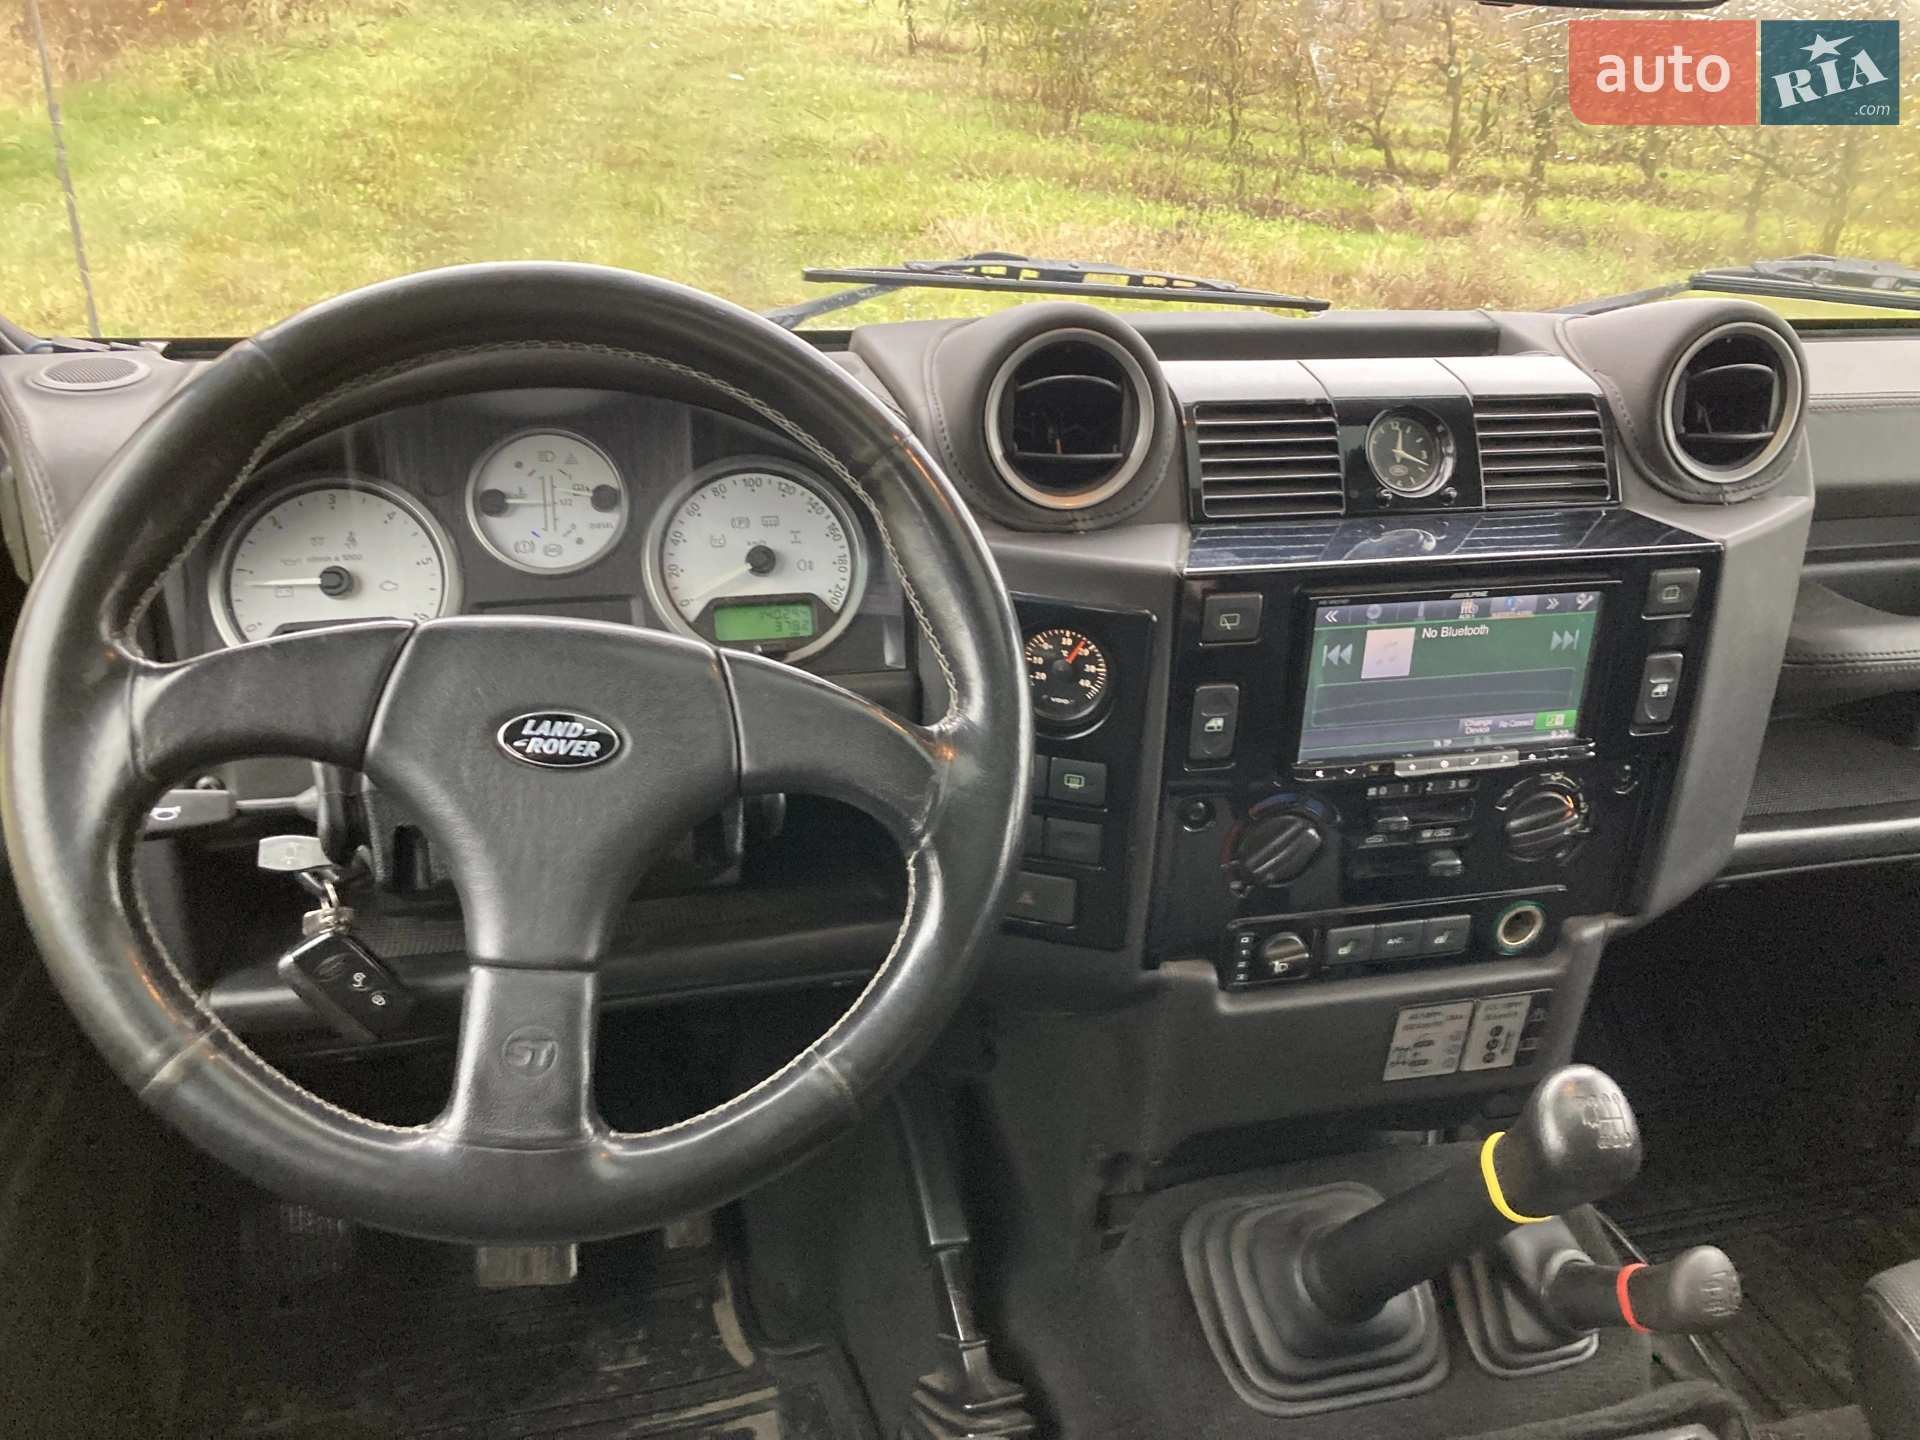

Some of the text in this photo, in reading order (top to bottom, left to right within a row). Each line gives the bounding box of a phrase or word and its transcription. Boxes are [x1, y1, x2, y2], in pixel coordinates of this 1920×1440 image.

[1420, 450, 1428, 459] 3
[742, 477, 763, 488] 100
[777, 482, 797, 496] 120
[711, 483, 727, 497] 80
[328, 493, 337, 505] 3
[806, 496, 825, 515] 140
[685, 502, 701, 517] 60
[670, 530, 684, 546] 40
[827, 521, 843, 542] 160
[420, 557, 433, 566] 5
[836, 553, 848, 573] 180
[668, 563, 681, 578] 20
[830, 583, 846, 606] 200
[680, 598, 691, 608] 0
[1421, 625, 1489, 639] No Bluetooth
[1084, 663, 1096, 673] 30
[521, 719, 584, 738] LAND
[1464, 719, 1493, 727] Change
[1464, 726, 1490, 734] Device
[525, 737, 602, 757] ROVER
[1426, 782, 1434, 791] 2
[1448, 780, 1457, 789] 3
